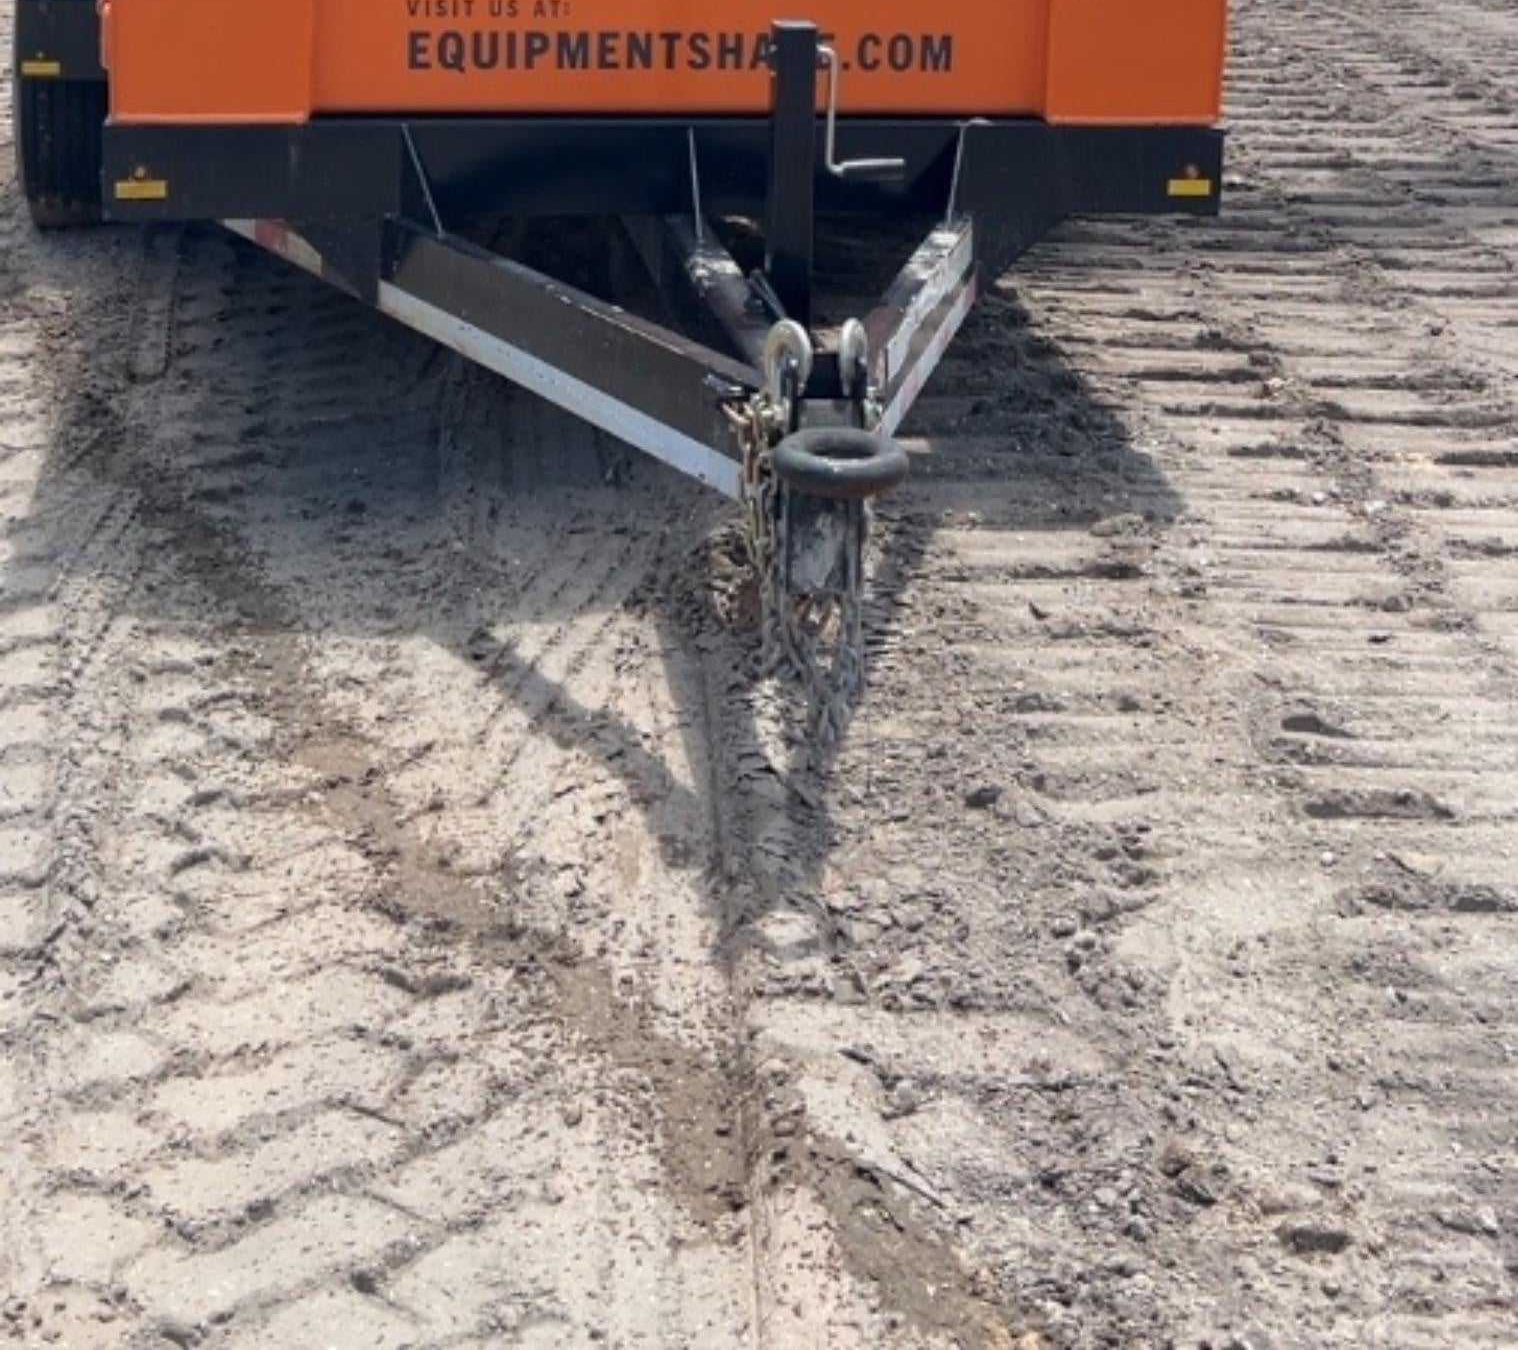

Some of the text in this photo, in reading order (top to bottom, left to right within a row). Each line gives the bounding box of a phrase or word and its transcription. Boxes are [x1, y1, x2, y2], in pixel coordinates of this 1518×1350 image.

[406, 0, 570, 19] VISIT US AT:
[407, 29, 954, 74] EQUIPMENTSHAE.COM
